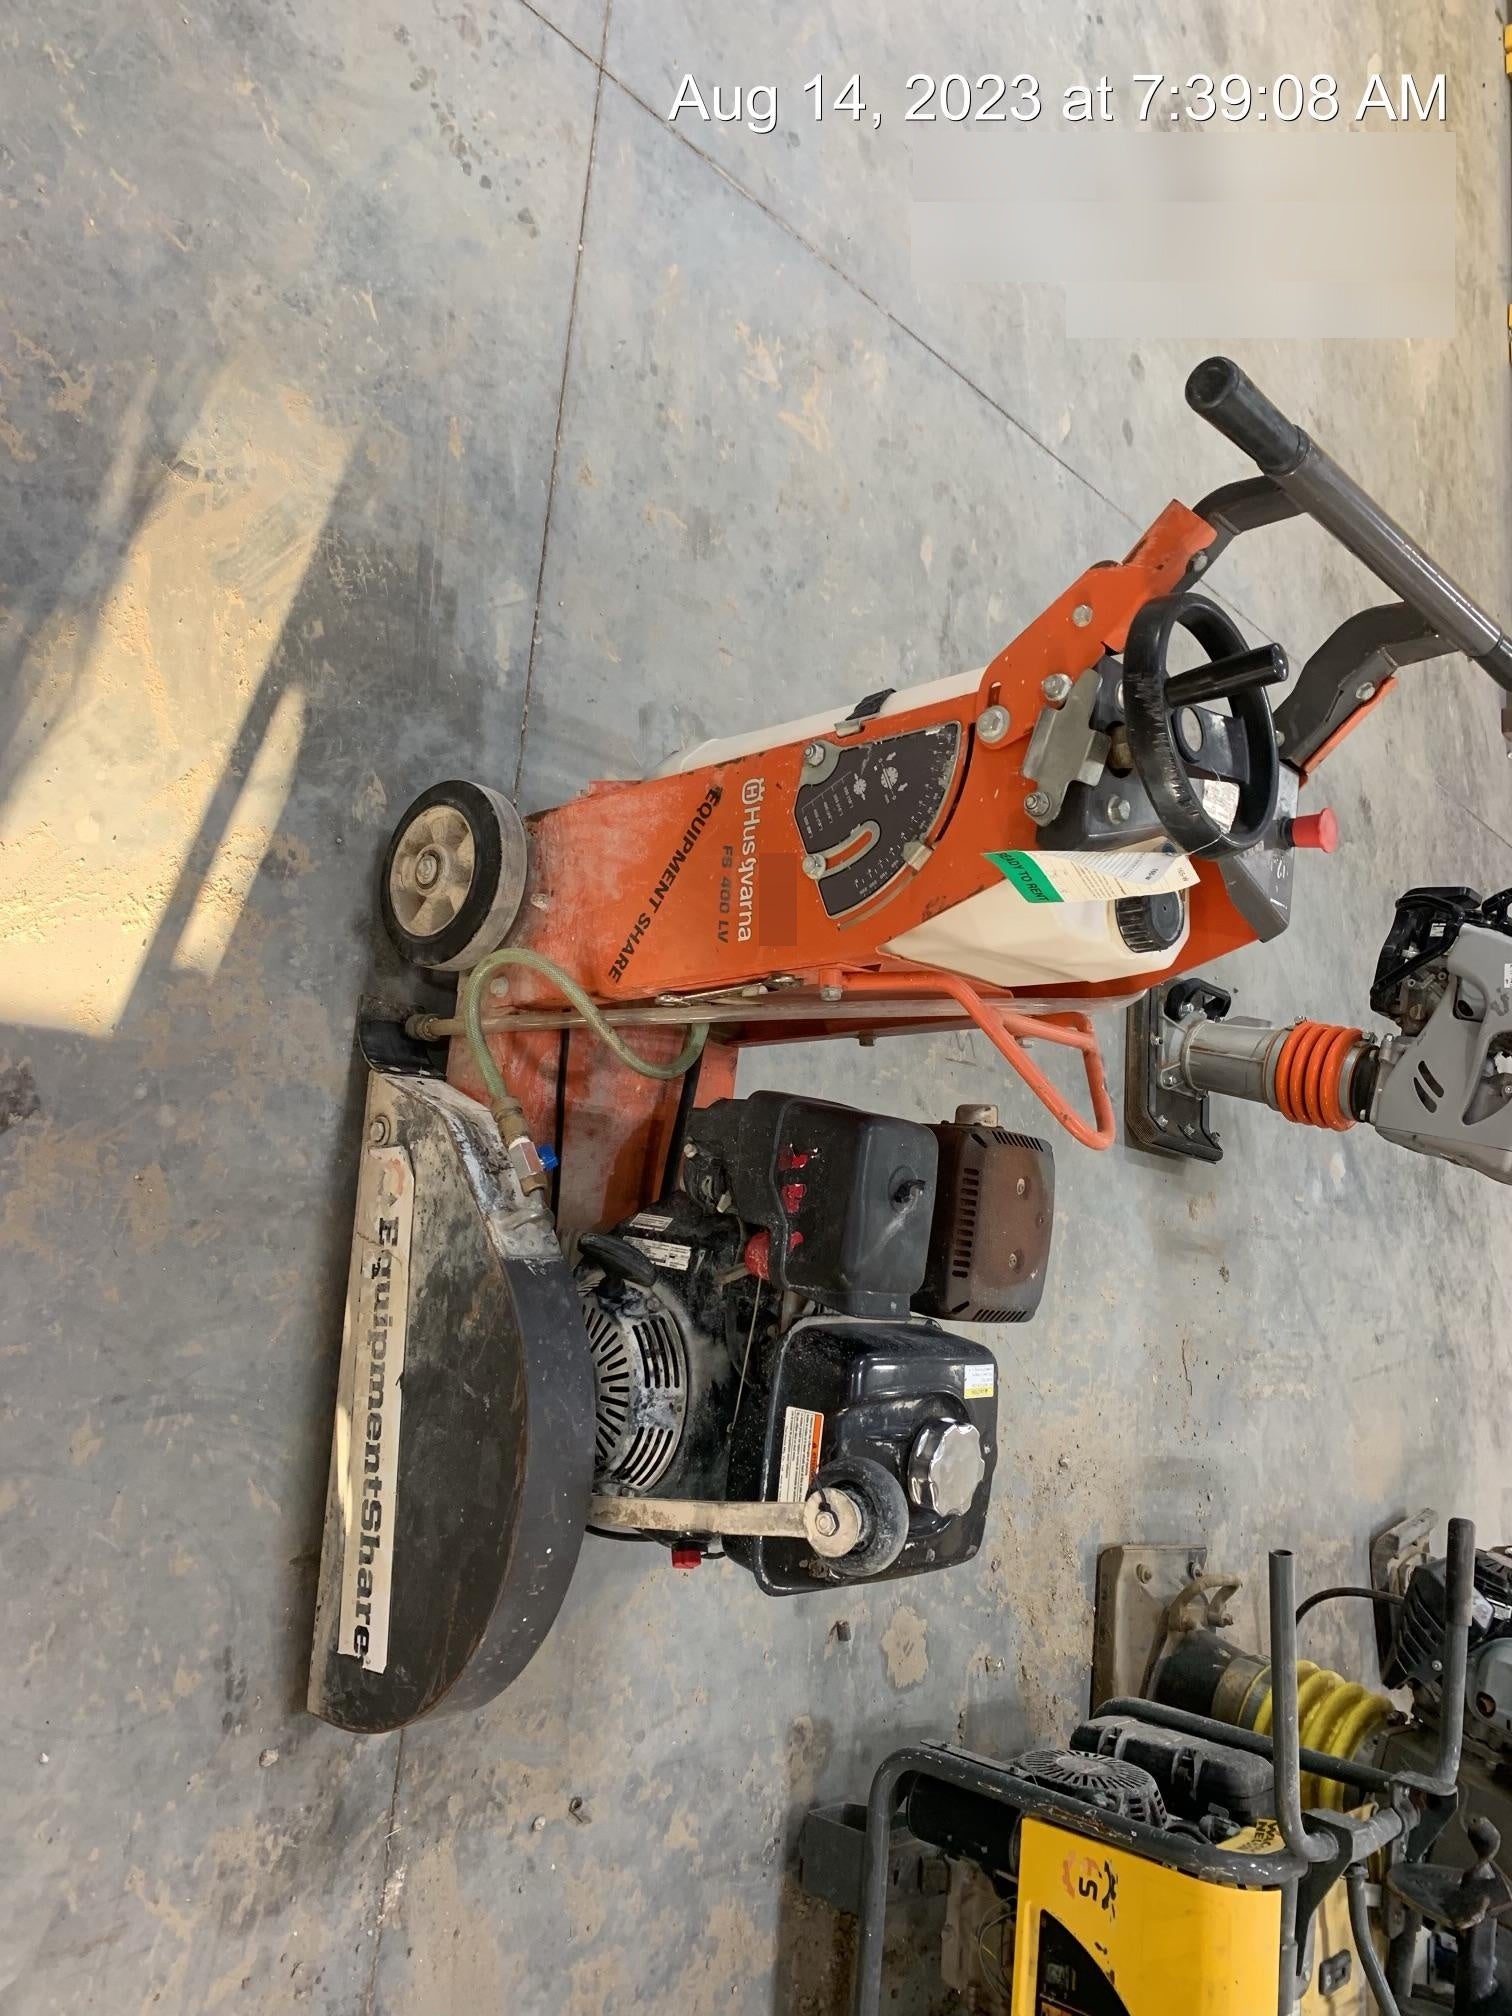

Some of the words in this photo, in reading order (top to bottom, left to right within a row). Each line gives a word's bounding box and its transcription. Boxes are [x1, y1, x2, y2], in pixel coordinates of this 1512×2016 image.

[648, 784, 723, 913] EQUIPMENT
[721, 845, 733, 869] FS
[738, 806, 761, 942] Husqvarna
[719, 876, 732, 914] 400
[1017, 870, 1033, 883] TO
[1025, 881, 1050, 901] RENT
[608, 912, 651, 984] SHARE
[717, 919, 729, 943] LV
[353, 1216, 399, 1657] EquipmentShare
